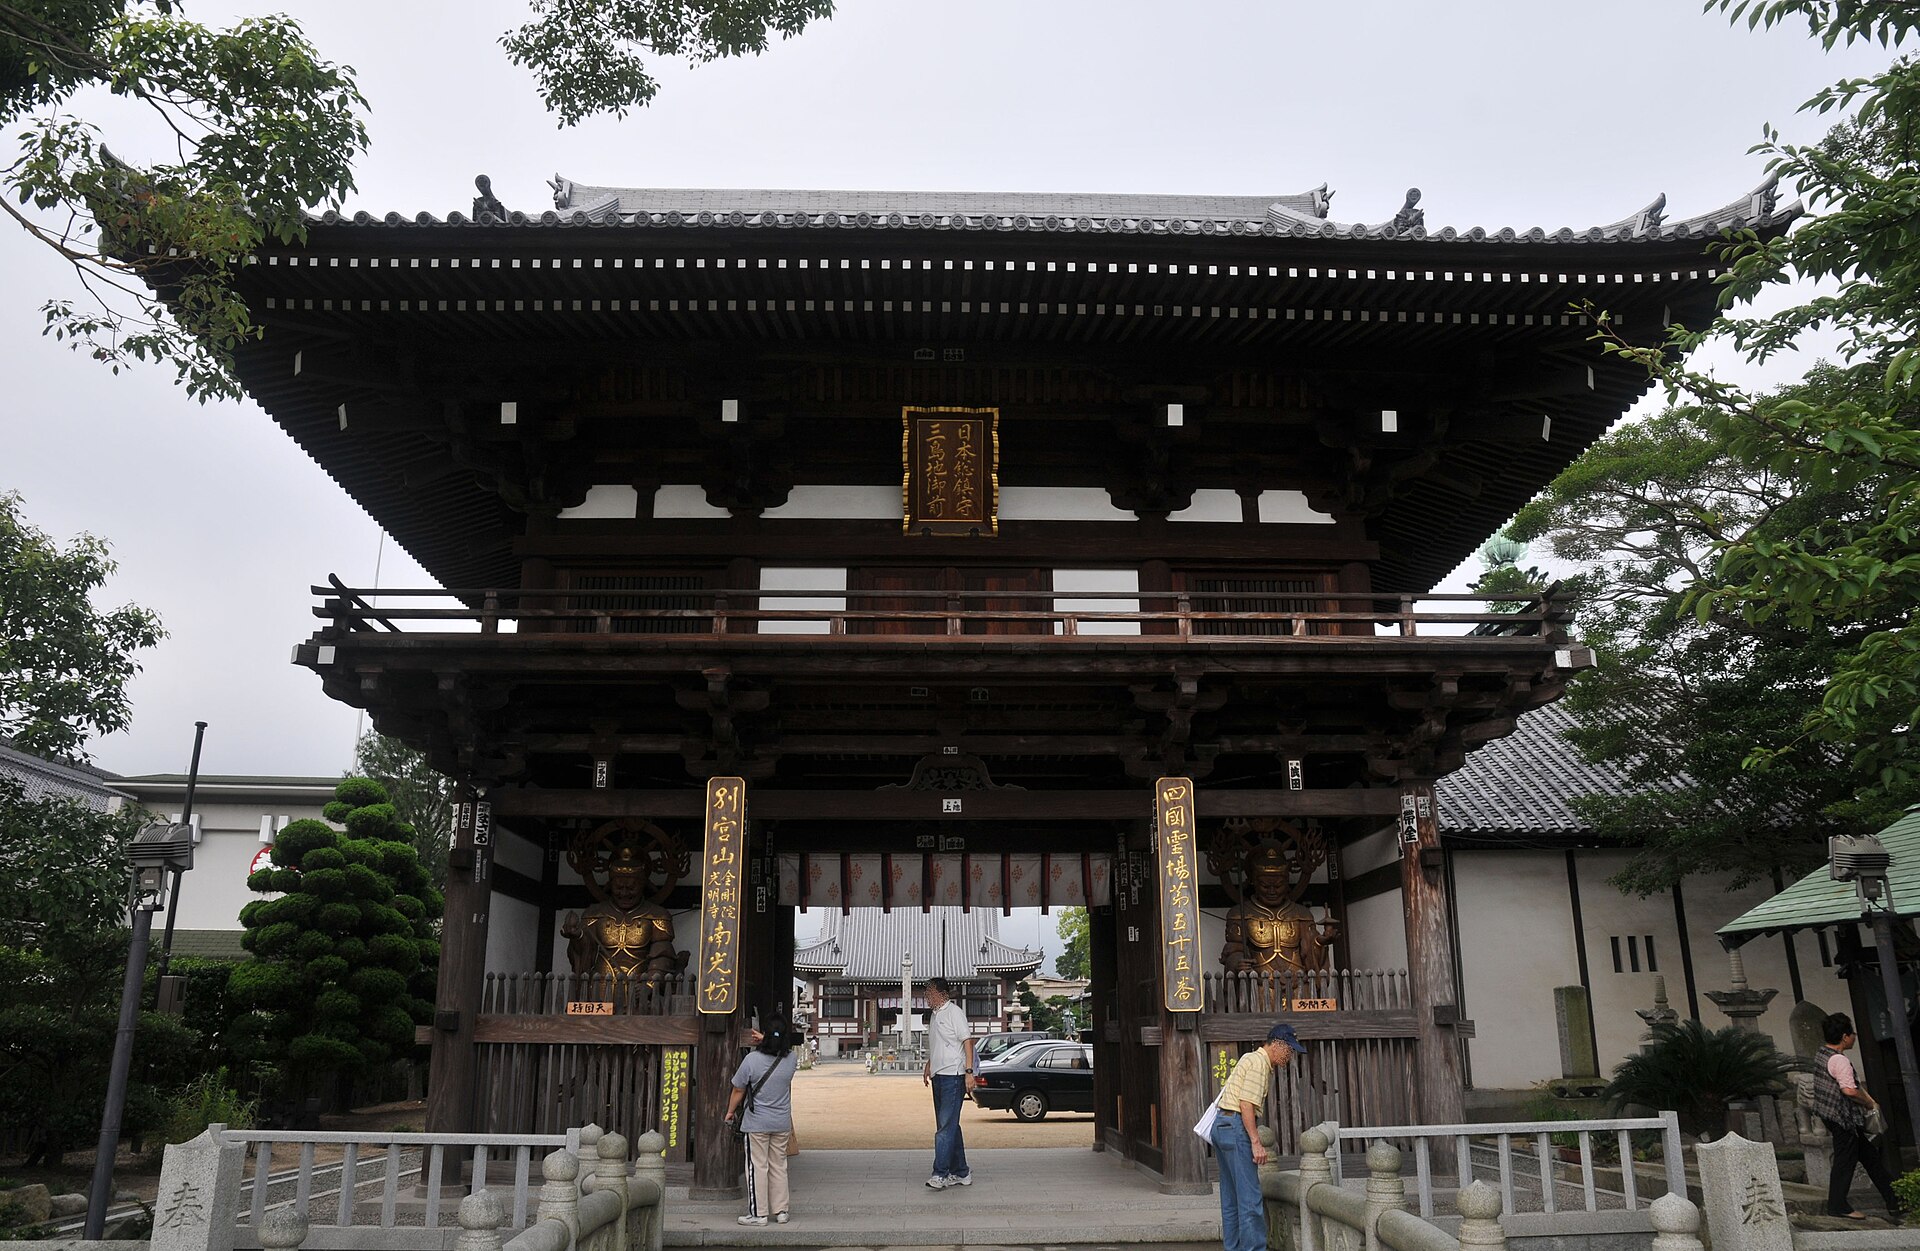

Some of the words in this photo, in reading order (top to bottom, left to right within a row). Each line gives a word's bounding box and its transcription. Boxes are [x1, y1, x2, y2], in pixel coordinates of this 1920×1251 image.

[925, 423, 948, 518] 三島地御前
[707, 871, 721, 919] 光明寺
[720, 869, 736, 919] 金剛院
[159, 1181, 206, 1237] 奉
[1742, 1177, 1784, 1231] 奉
